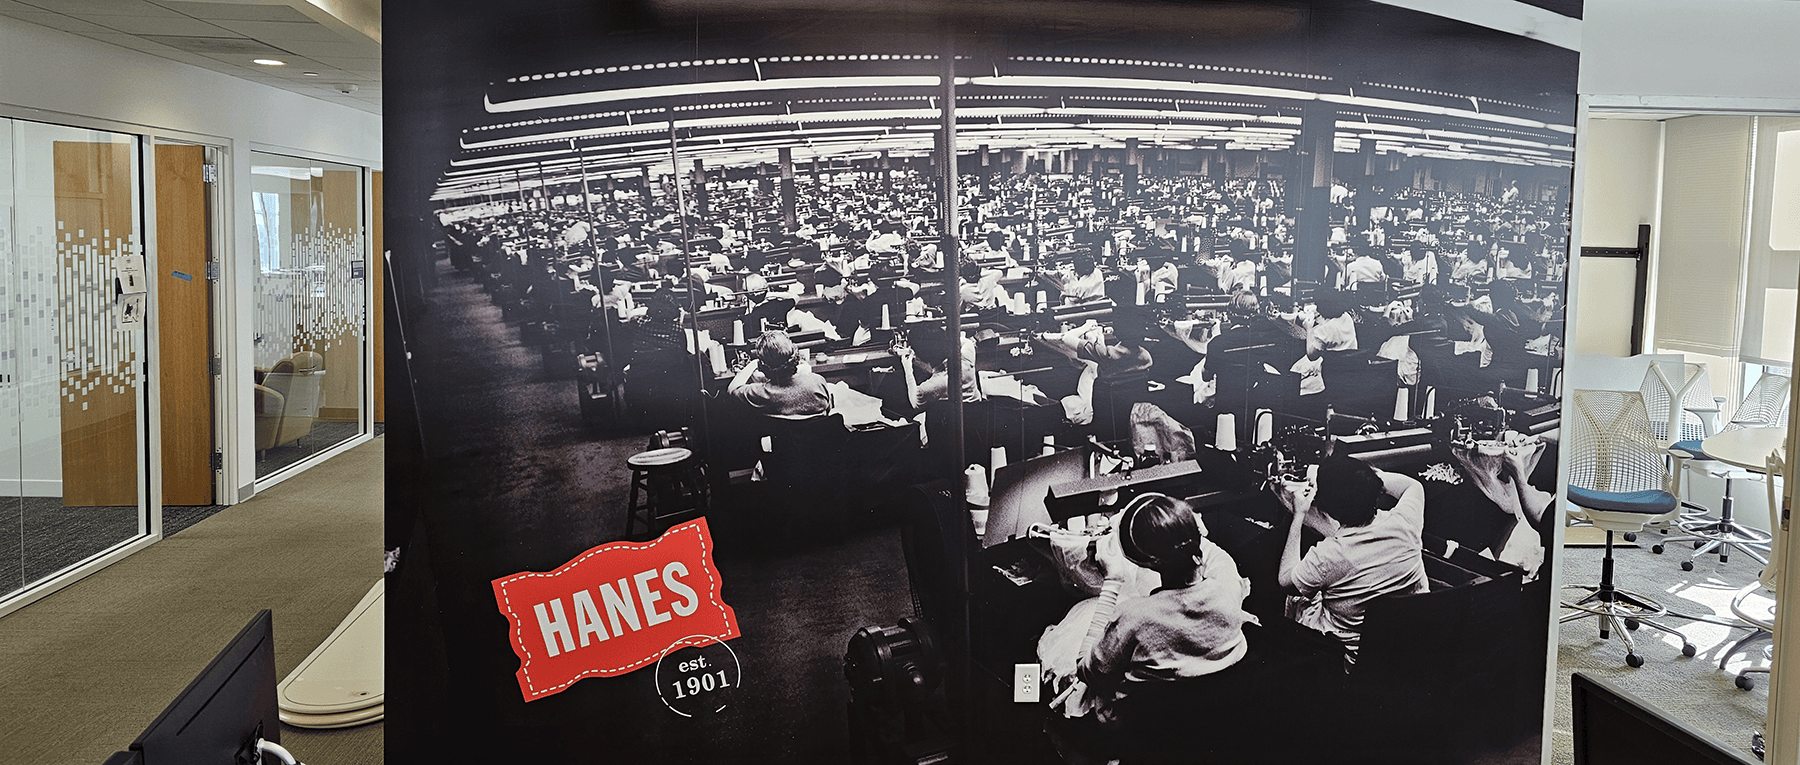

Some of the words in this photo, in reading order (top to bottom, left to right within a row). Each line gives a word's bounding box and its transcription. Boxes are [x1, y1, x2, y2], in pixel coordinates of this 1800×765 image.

[533, 561, 699, 658] HANES
[678, 654, 712, 673] est.
[672, 669, 730, 699] 1901
